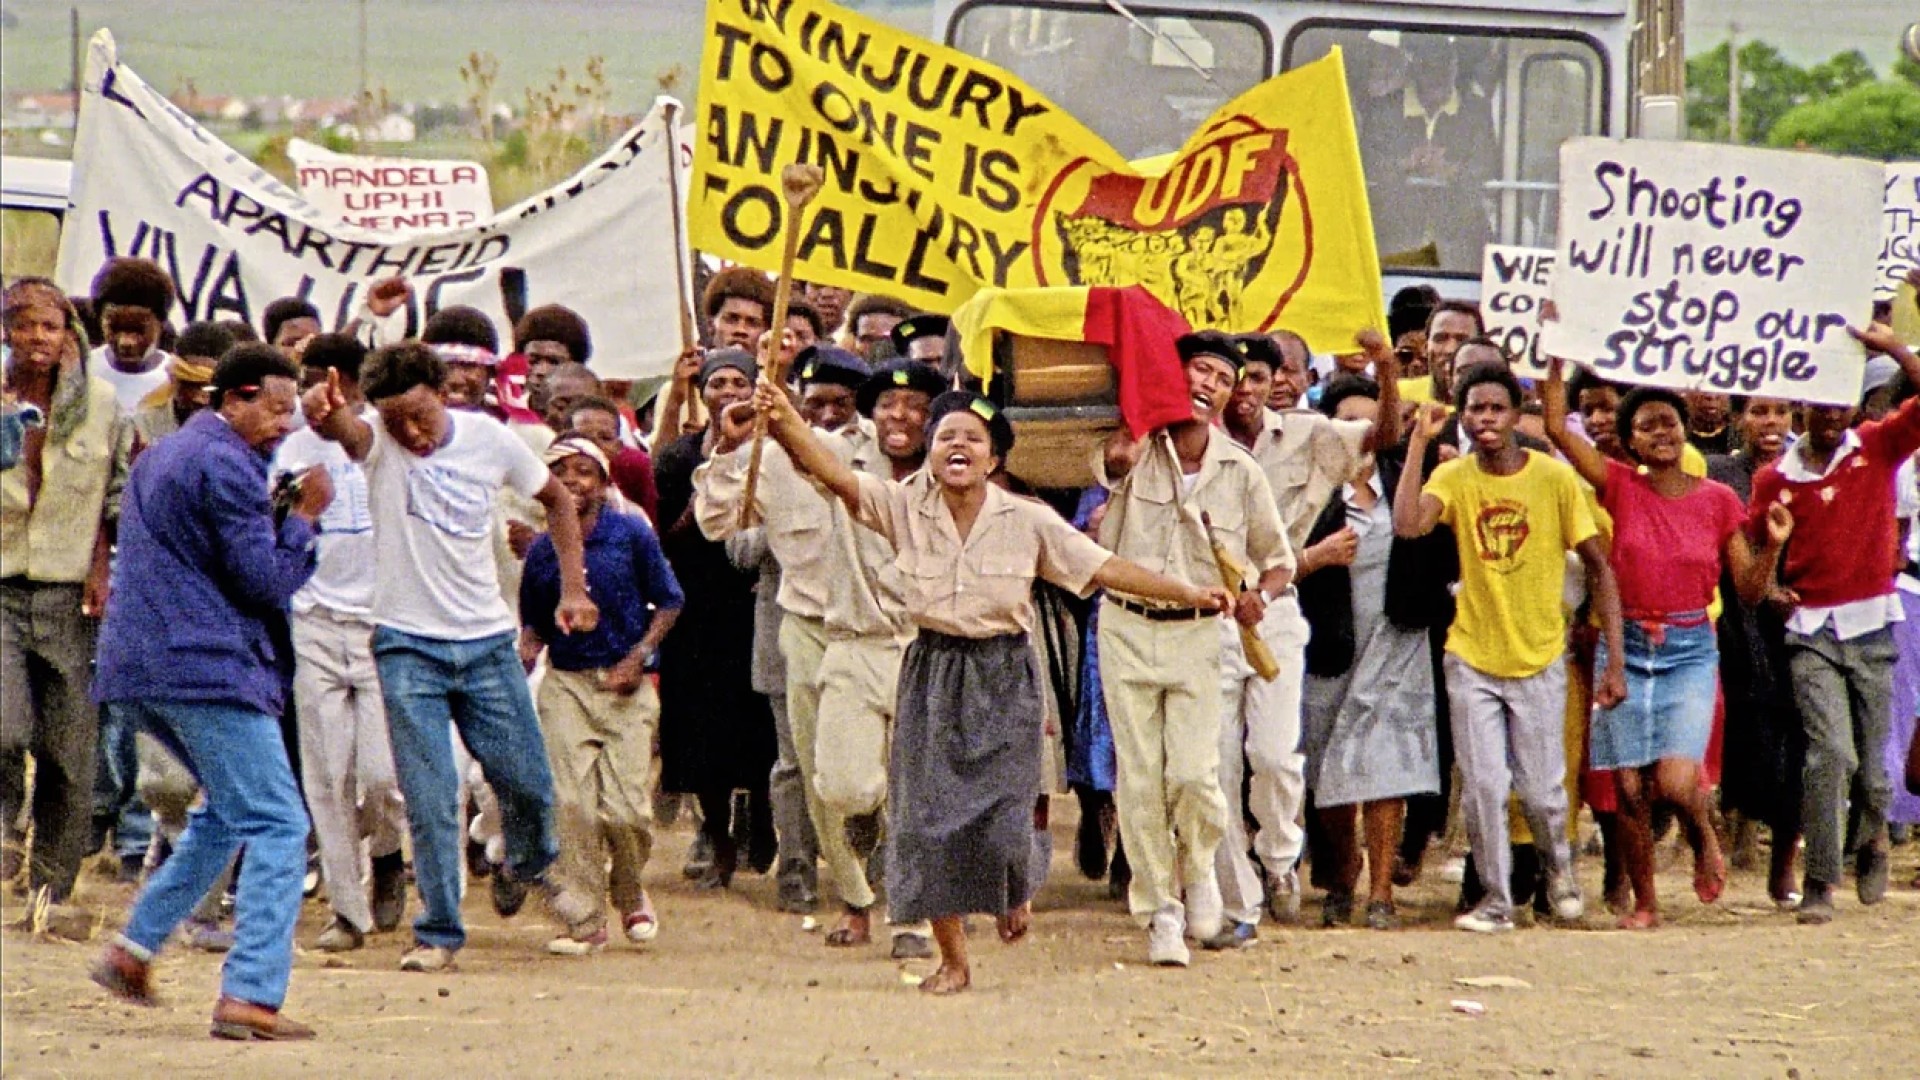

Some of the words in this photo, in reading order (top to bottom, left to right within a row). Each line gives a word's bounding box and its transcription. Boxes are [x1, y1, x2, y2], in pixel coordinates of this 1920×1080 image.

[719, 0, 793, 35] N
[799, 11, 1050, 136] INJURY
[708, 103, 784, 176] AN
[715, 21, 794, 93] TO
[811, 80, 942, 182] ONE
[958, 143, 1022, 213] IS
[300, 167, 478, 188] MANDELA
[344, 190, 443, 211] UPHI
[1132, 133, 1274, 227] UDF
[1589, 161, 1803, 239] Shooting
[174, 172, 511, 277] APARTHEID
[797, 206, 949, 296] ALL
[1569, 223, 1653, 279] will
[1672, 243, 1804, 282] never
[1491, 251, 1556, 285] WE
[1623, 280, 1739, 341] stop
[1755, 313, 1847, 340] our
[1595, 322, 1819, 391] struggle
